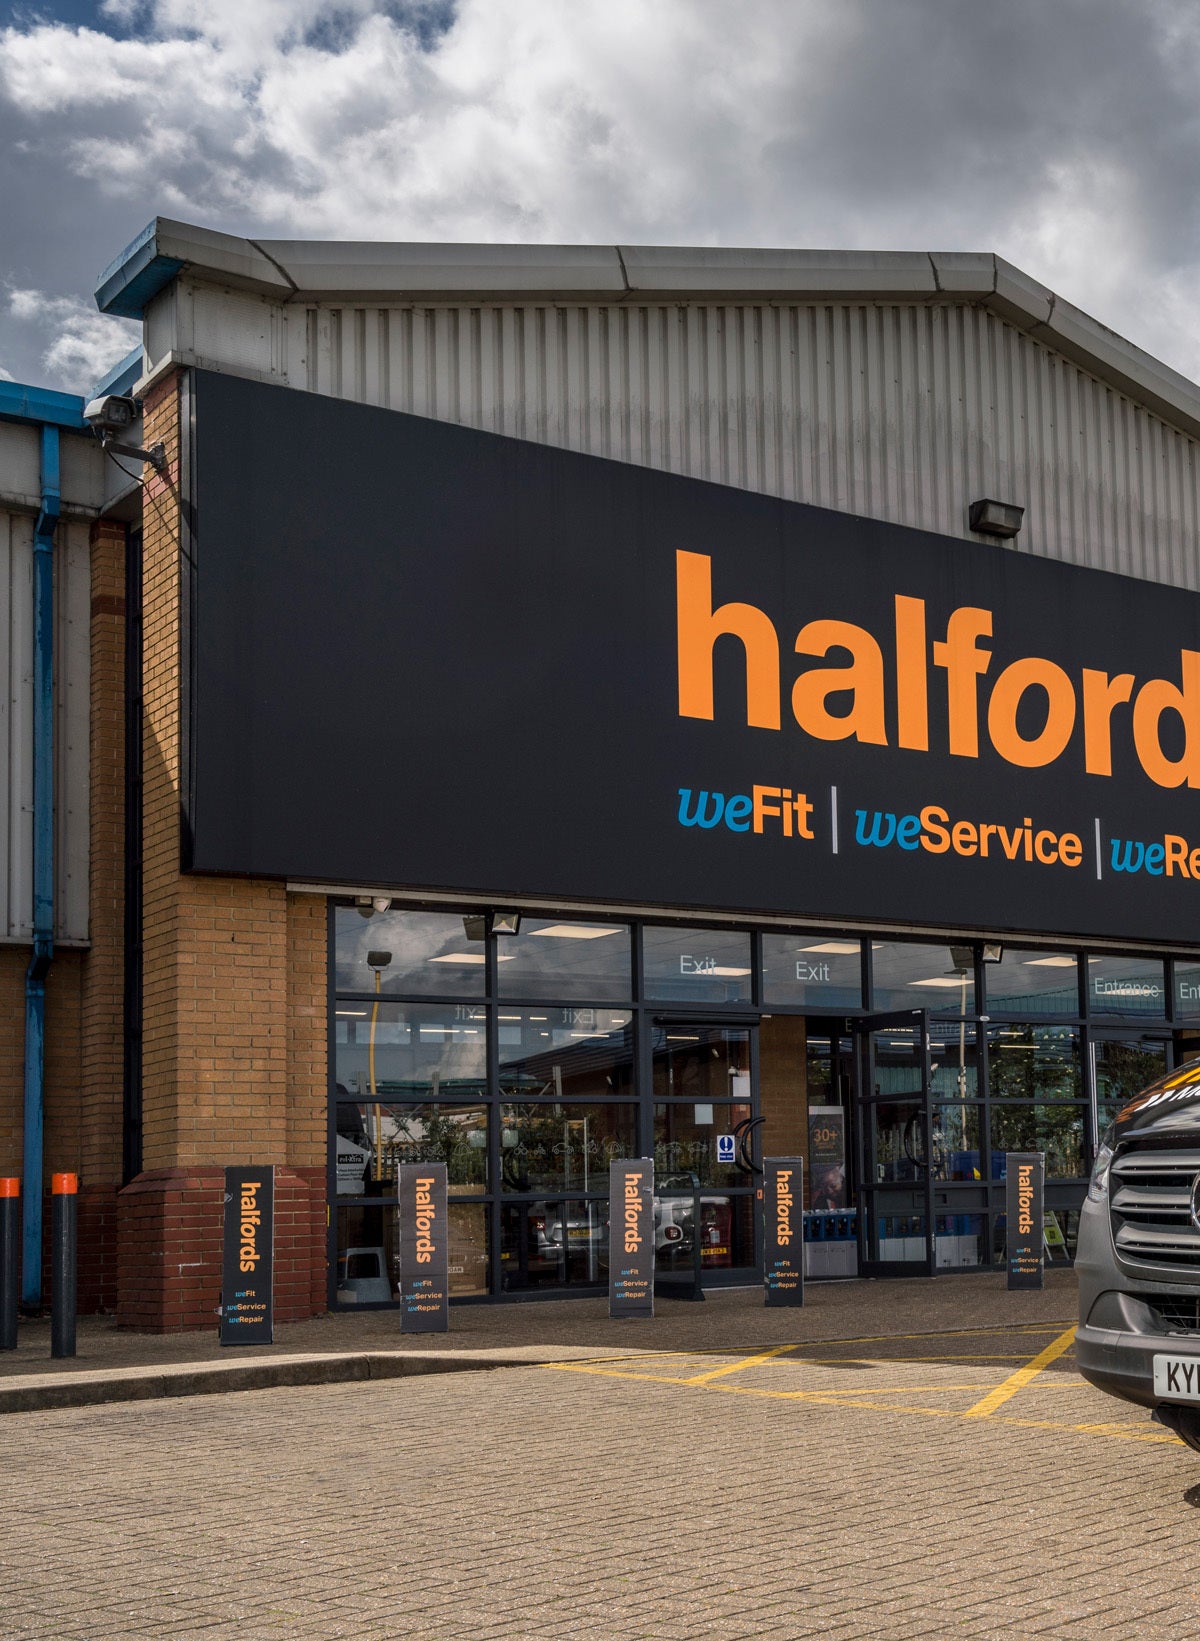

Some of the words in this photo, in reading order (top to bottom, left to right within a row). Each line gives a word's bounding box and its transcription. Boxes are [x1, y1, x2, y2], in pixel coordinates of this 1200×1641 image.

[678, 785, 814, 839] weFit
[855, 806, 1082, 867] weService
[680, 955, 717, 975] Exit
[796, 961, 830, 981] Exit
[1094, 978, 1159, 998] Entrance
[240, 1182, 261, 1272] halfords
[416, 1178, 435, 1263] halfords
[625, 1173, 642, 1253] halfords
[777, 1170, 793, 1246] halfords
[1019, 1165, 1034, 1234] halfords
